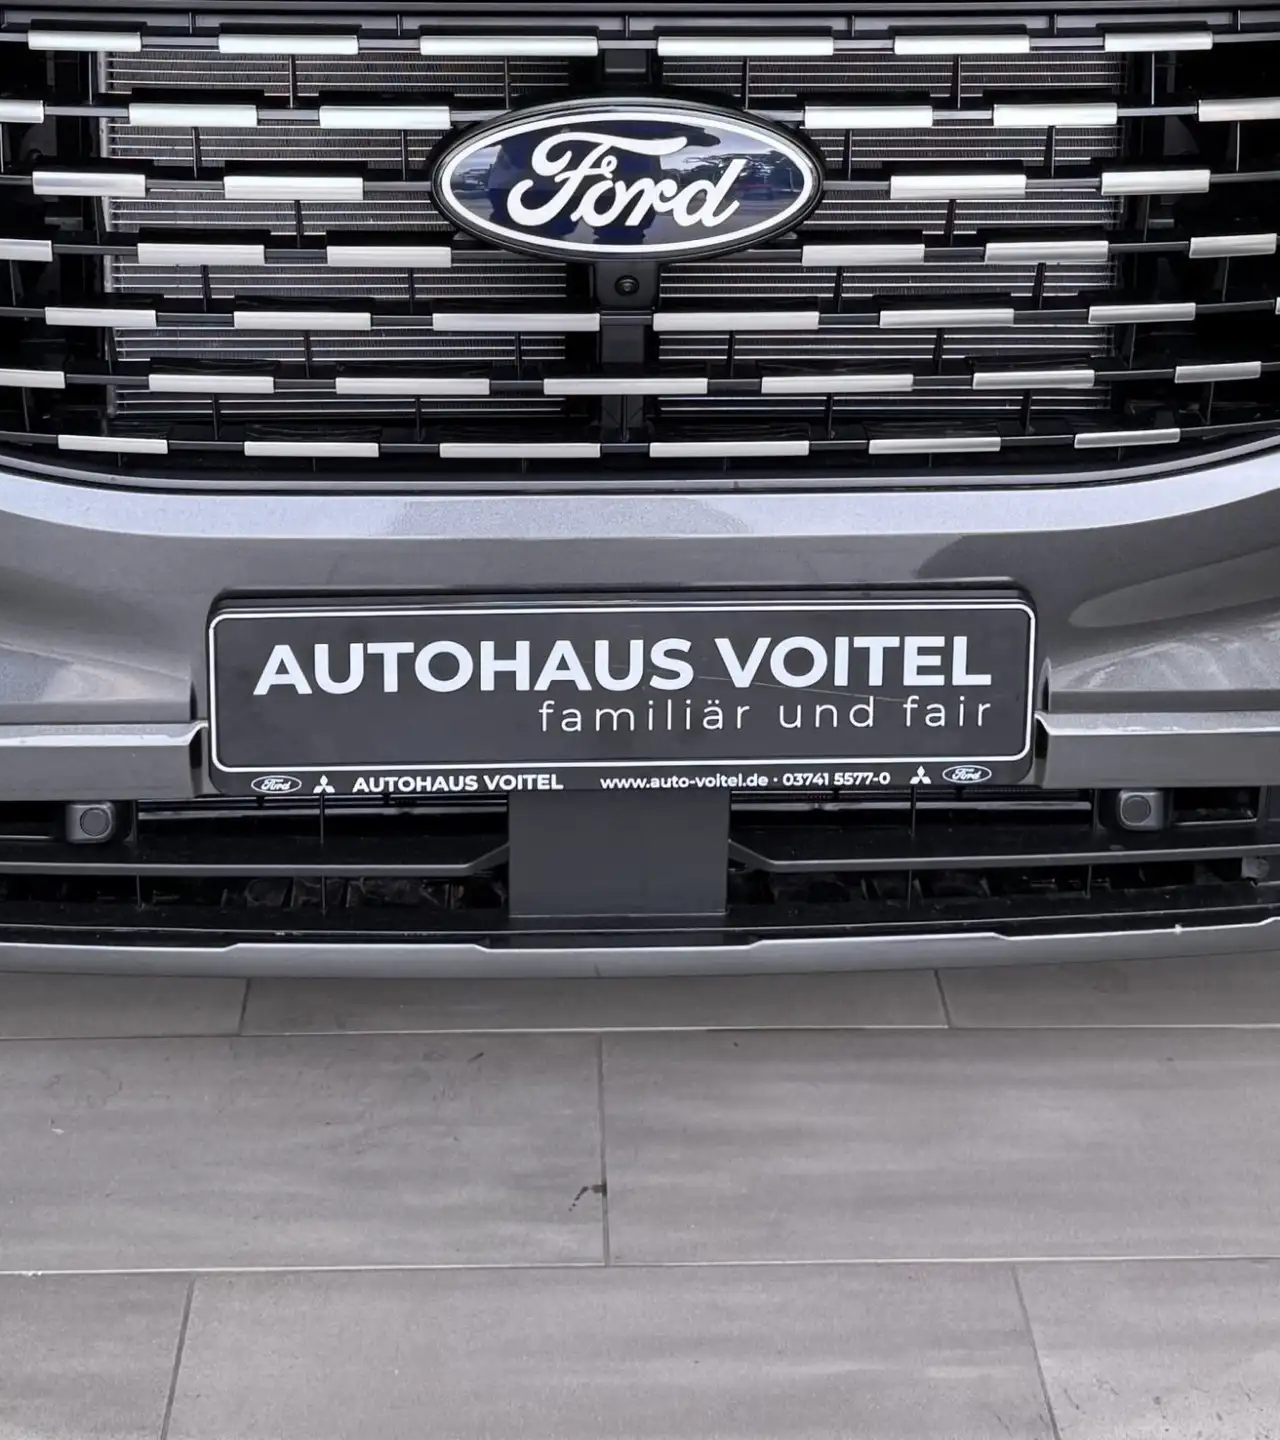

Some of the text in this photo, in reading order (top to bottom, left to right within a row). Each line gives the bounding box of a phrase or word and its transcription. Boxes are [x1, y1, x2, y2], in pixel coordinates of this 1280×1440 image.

[506, 131, 747, 228] Ford
[252, 635, 992, 696] AUTOHAUS VOITEL
[539, 694, 991, 732] familiär und fair
[351, 773, 564, 793] AUTOHAUS VOITEL
[600, 771, 891, 790] www.auto-voitel.de 03741 5577-0
